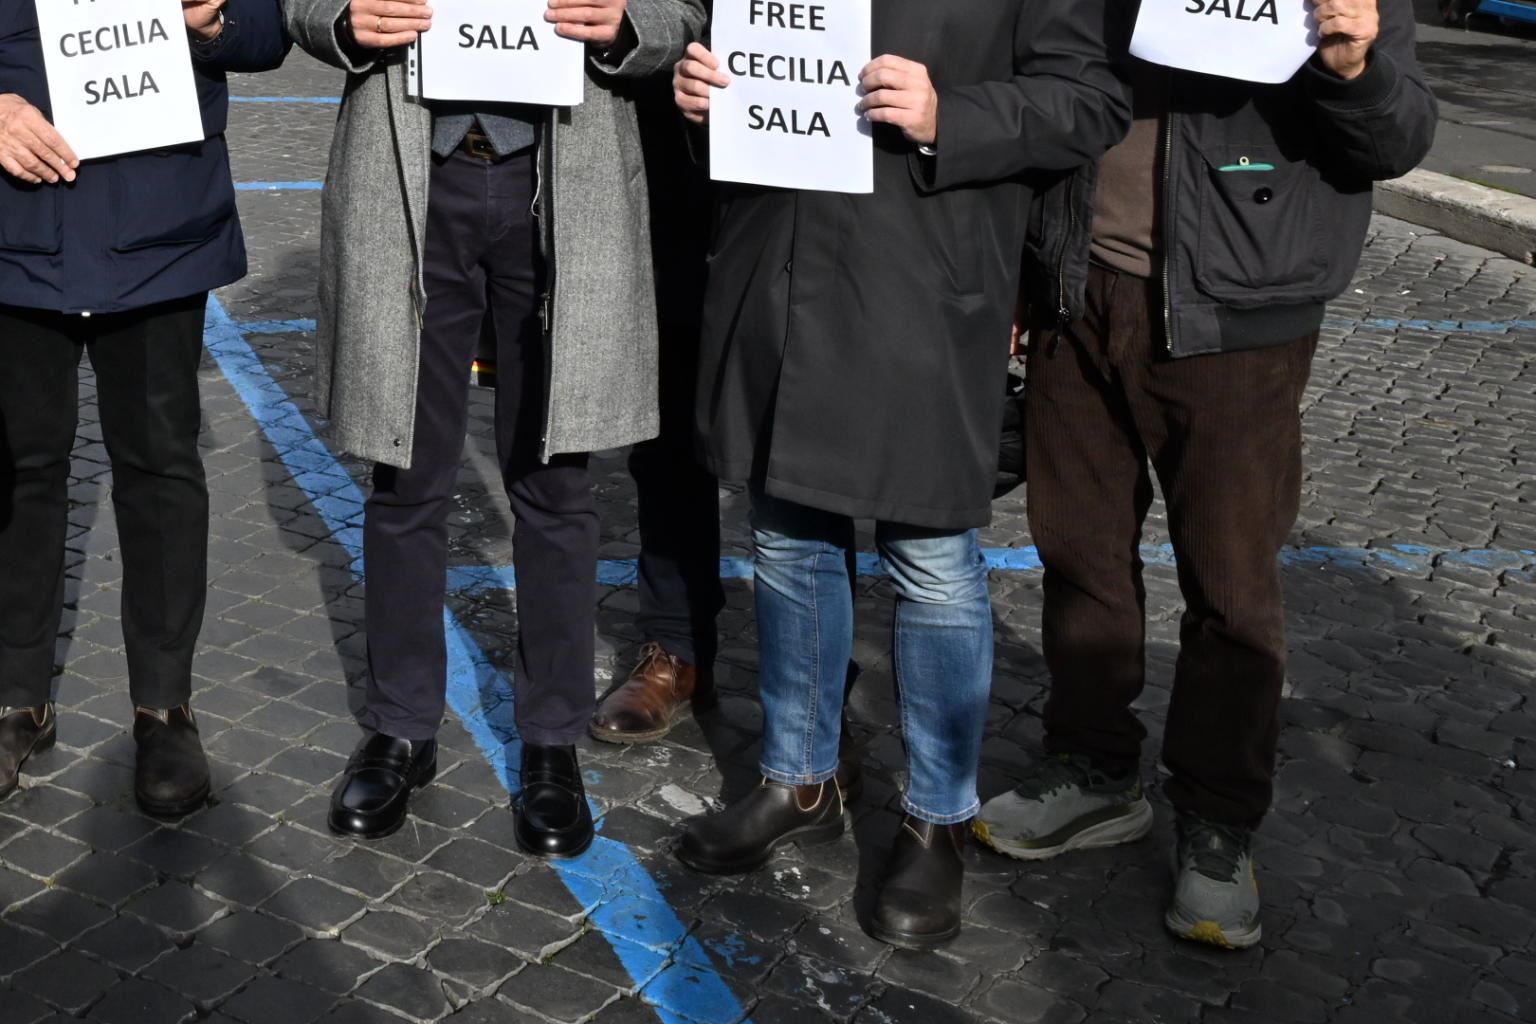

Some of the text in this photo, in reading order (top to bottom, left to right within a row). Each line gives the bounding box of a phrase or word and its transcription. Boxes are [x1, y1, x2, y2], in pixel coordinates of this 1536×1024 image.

[749, 0, 826, 31] FREE
[59, 18, 169, 58] CECILIA
[458, 23, 540, 51] SALA
[727, 50, 851, 86] CECILIA
[84, 70, 160, 105] SALA
[748, 104, 831, 138] SALA
